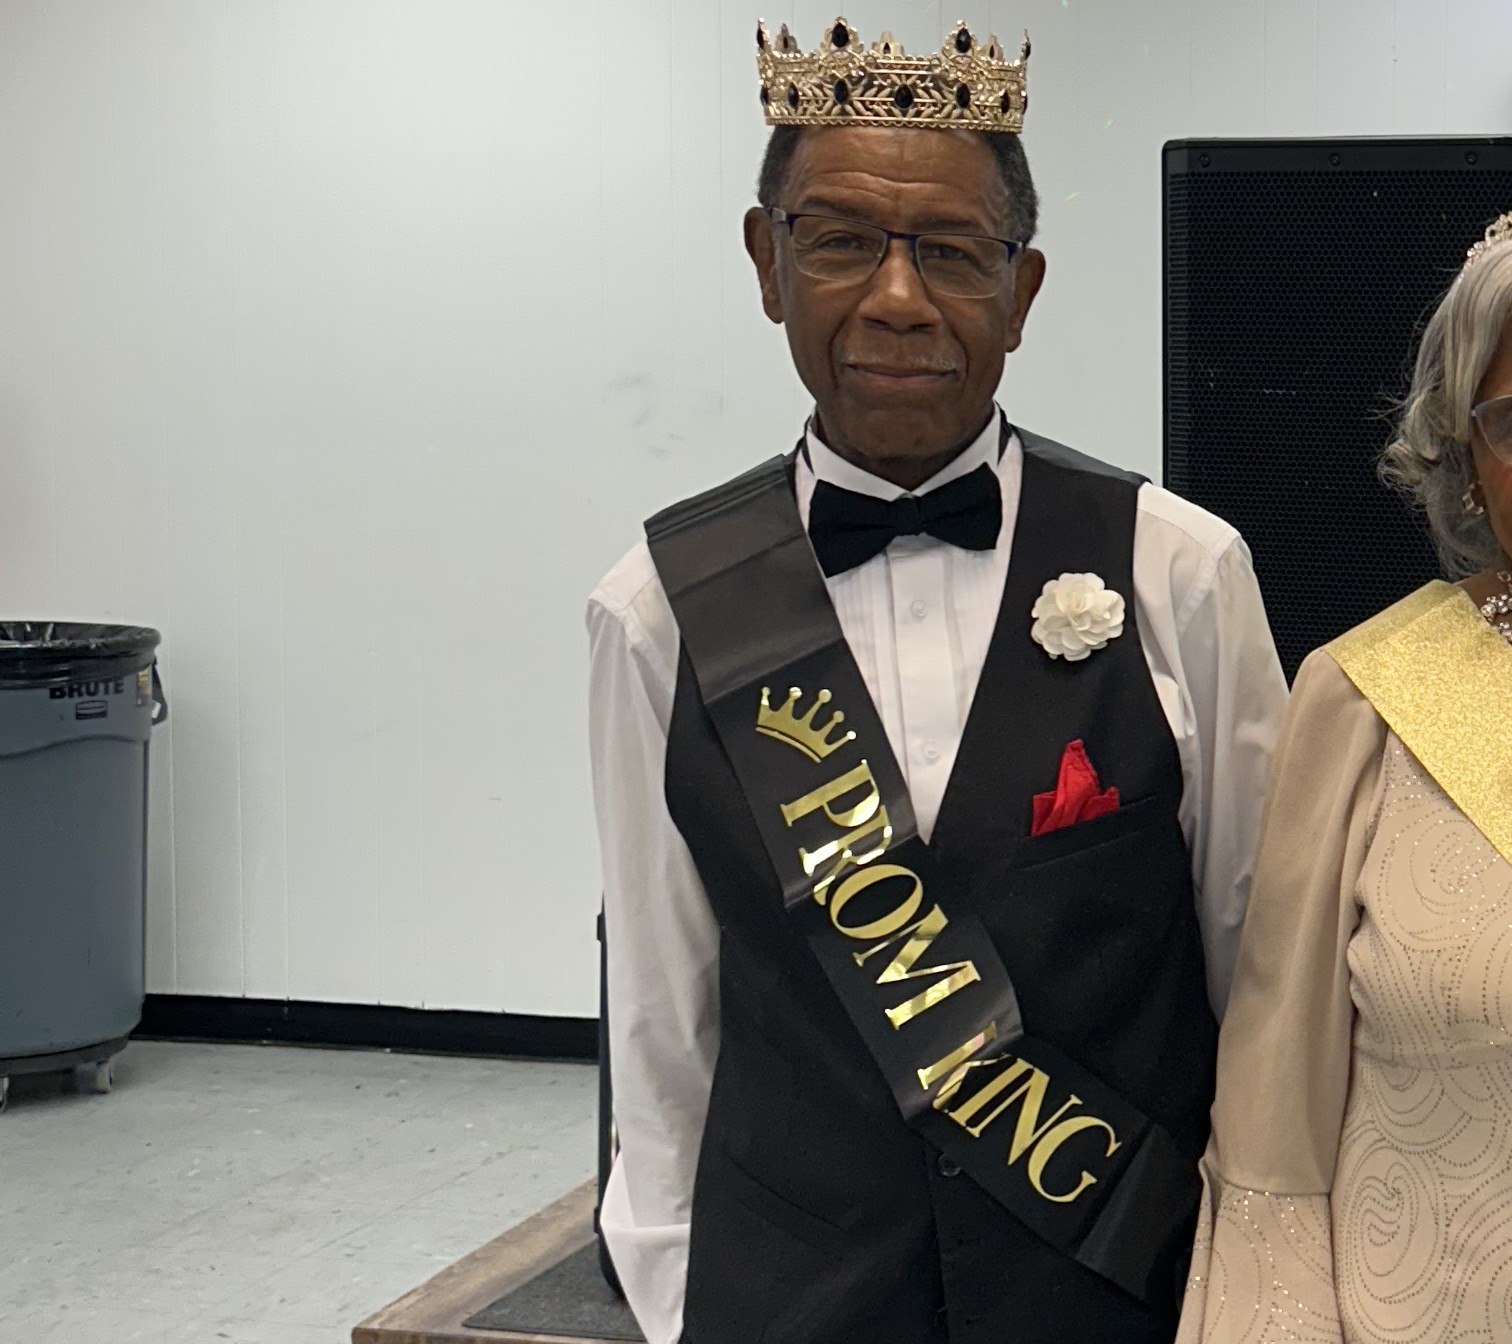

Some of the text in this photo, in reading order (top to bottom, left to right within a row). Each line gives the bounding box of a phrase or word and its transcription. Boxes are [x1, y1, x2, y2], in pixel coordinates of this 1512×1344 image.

[49, 676, 124, 699] BRUTE
[780, 759, 1122, 1202] PROM KING
